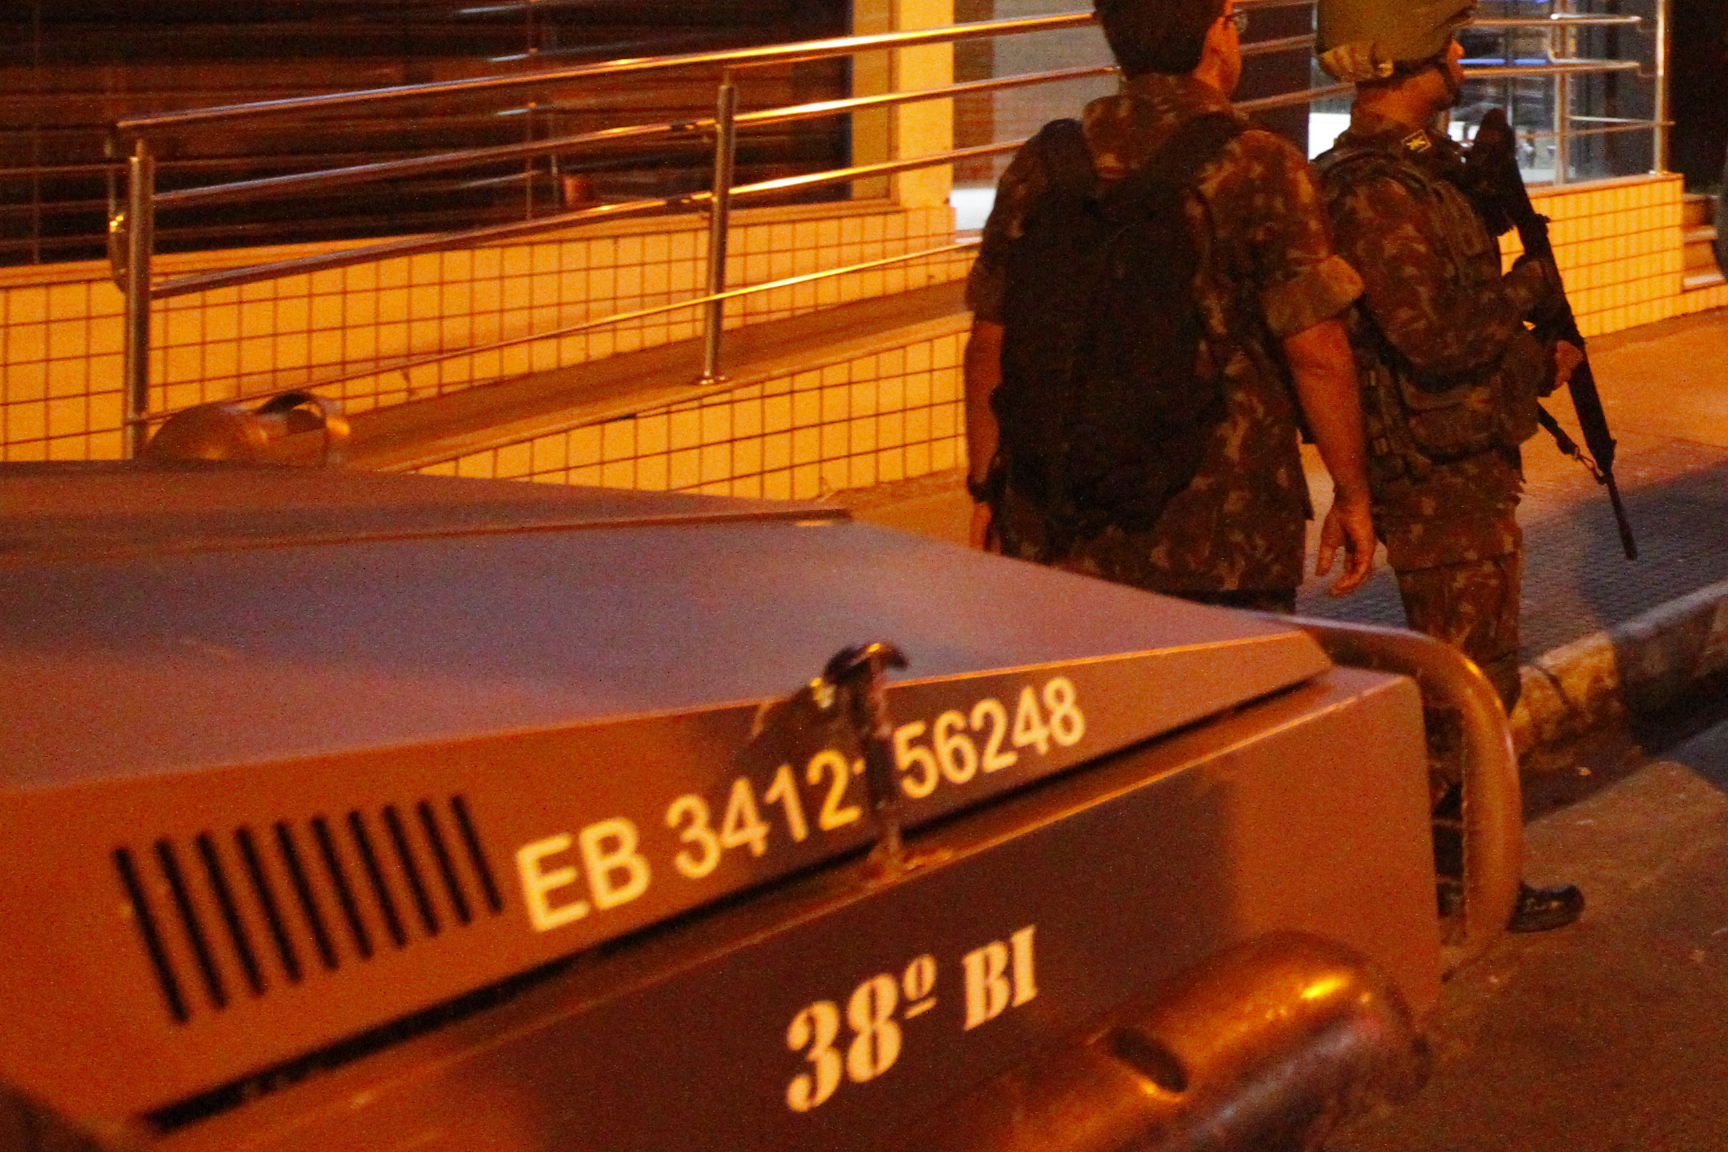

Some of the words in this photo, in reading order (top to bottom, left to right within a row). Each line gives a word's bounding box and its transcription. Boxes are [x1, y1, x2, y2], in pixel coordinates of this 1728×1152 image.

[517, 817, 652, 932] EB
[784, 953, 939, 1113] 38º
[963, 924, 1039, 1031] BI
